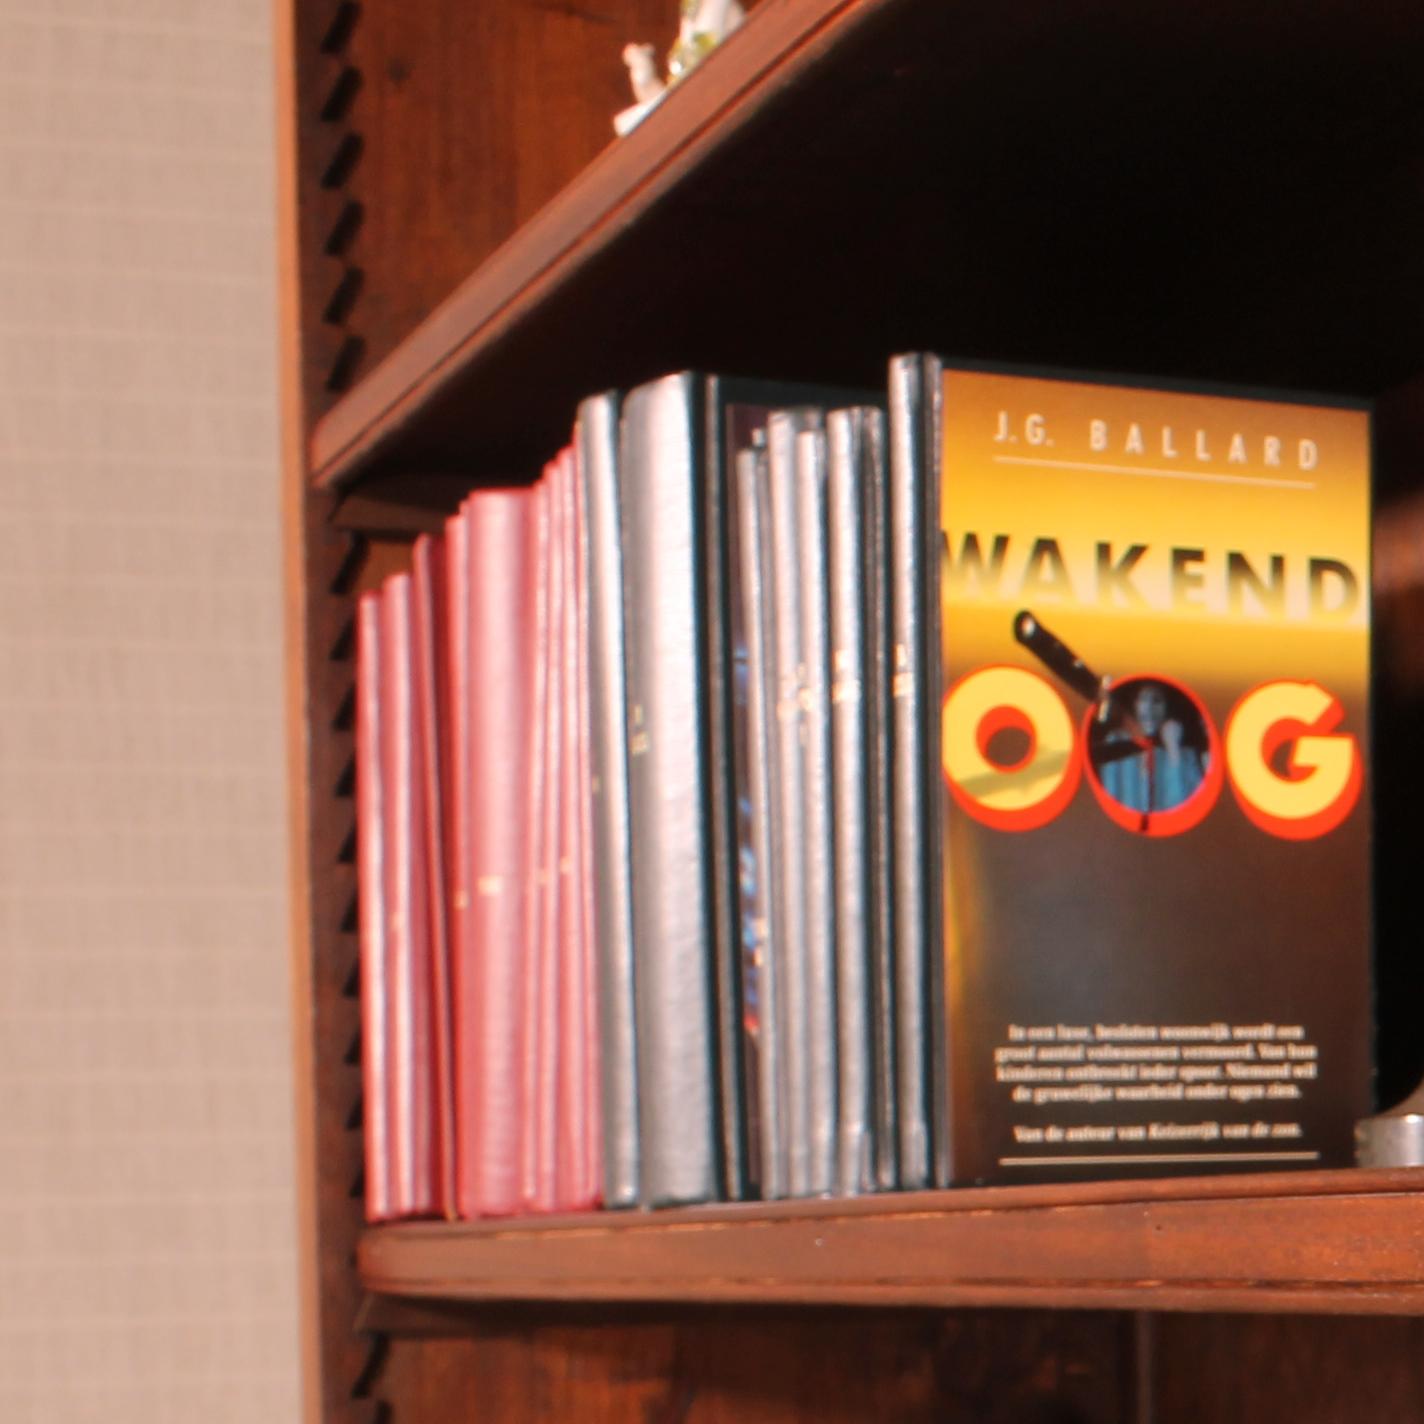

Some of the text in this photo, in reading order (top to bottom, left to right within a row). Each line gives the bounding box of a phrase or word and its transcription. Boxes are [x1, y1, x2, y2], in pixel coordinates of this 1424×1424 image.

[993, 411, 1318, 470] J.G. BALLARD
[940, 528, 1362, 628] WAKEND
[941, 661, 1363, 841] OOG
